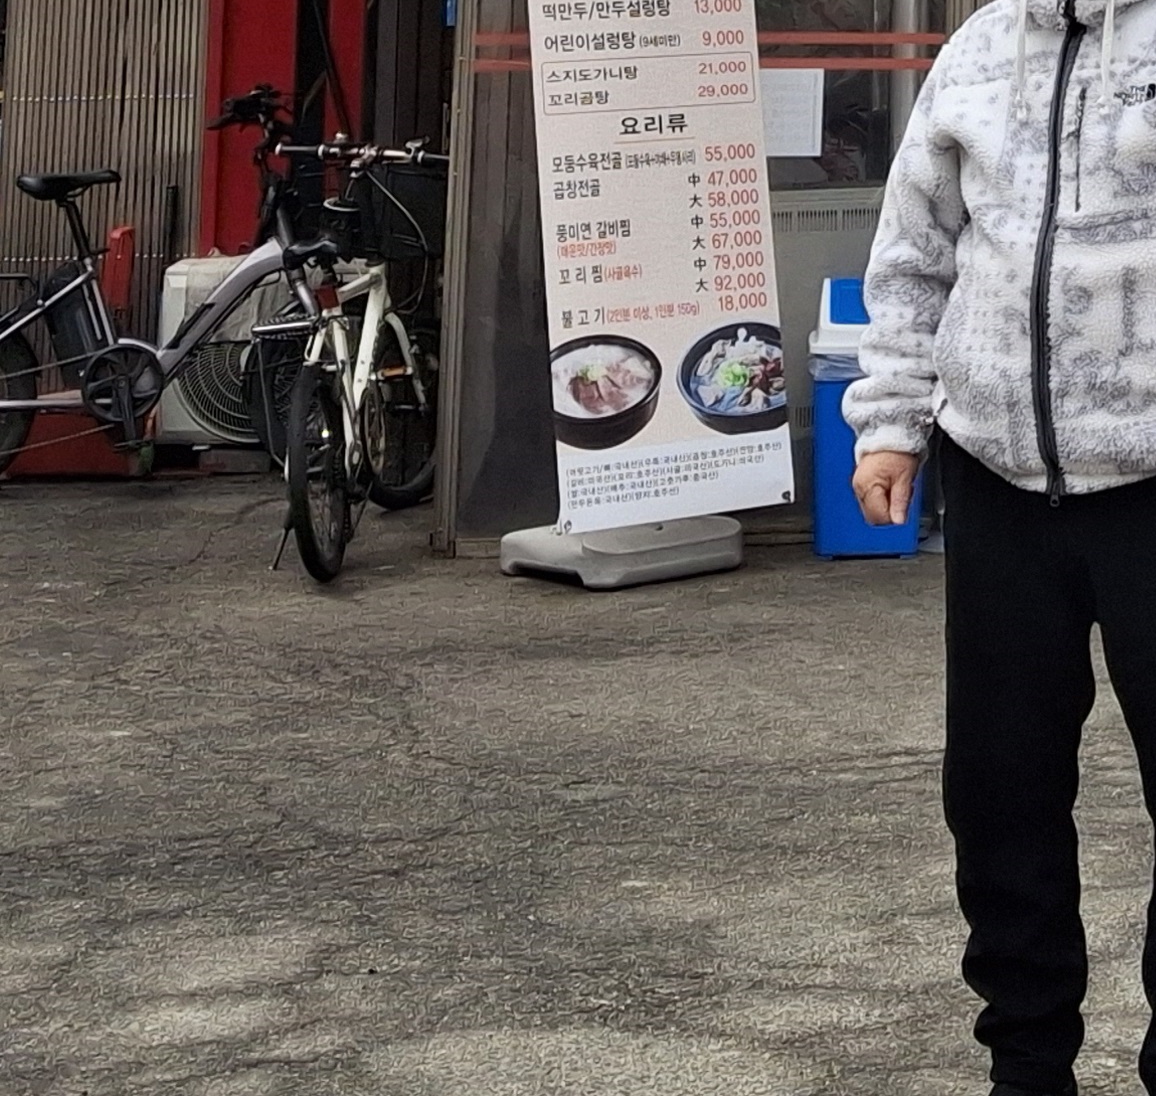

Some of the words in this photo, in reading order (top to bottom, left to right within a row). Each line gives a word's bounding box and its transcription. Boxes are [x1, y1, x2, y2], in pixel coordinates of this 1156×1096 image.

[544, 31, 636, 53] 어린이설렁탕
[702, 30, 744, 47] 9,000
[546, 65, 638, 83] 스지도가니탕
[698, 61, 747, 76] 21,000
[547, 90, 610, 107] 꼬리곰탕
[698, 84, 748, 98] 29,000
[619, 113, 689, 136] 요리류
[704, 143, 756, 162] 55,000
[553, 178, 601, 200] 곱창전골
[687, 172, 701, 188] 中
[707, 168, 757, 187] 47,000
[688, 193, 703, 209] 大
[707, 189, 759, 208] 58,000
[556, 222, 592, 243] 풍미연
[596, 218, 631, 239] 갈비찜
[690, 214, 704, 230] 中
[709, 209, 761, 229] 55,000
[691, 236, 706, 251] 大
[711, 230, 762, 249] 67,000
[693, 257, 707, 272] 中
[713, 251, 764, 271] 79,000
[695, 278, 709, 293] 大
[714, 272, 766, 292] 92,000
[717, 292, 768, 312] 18,000
